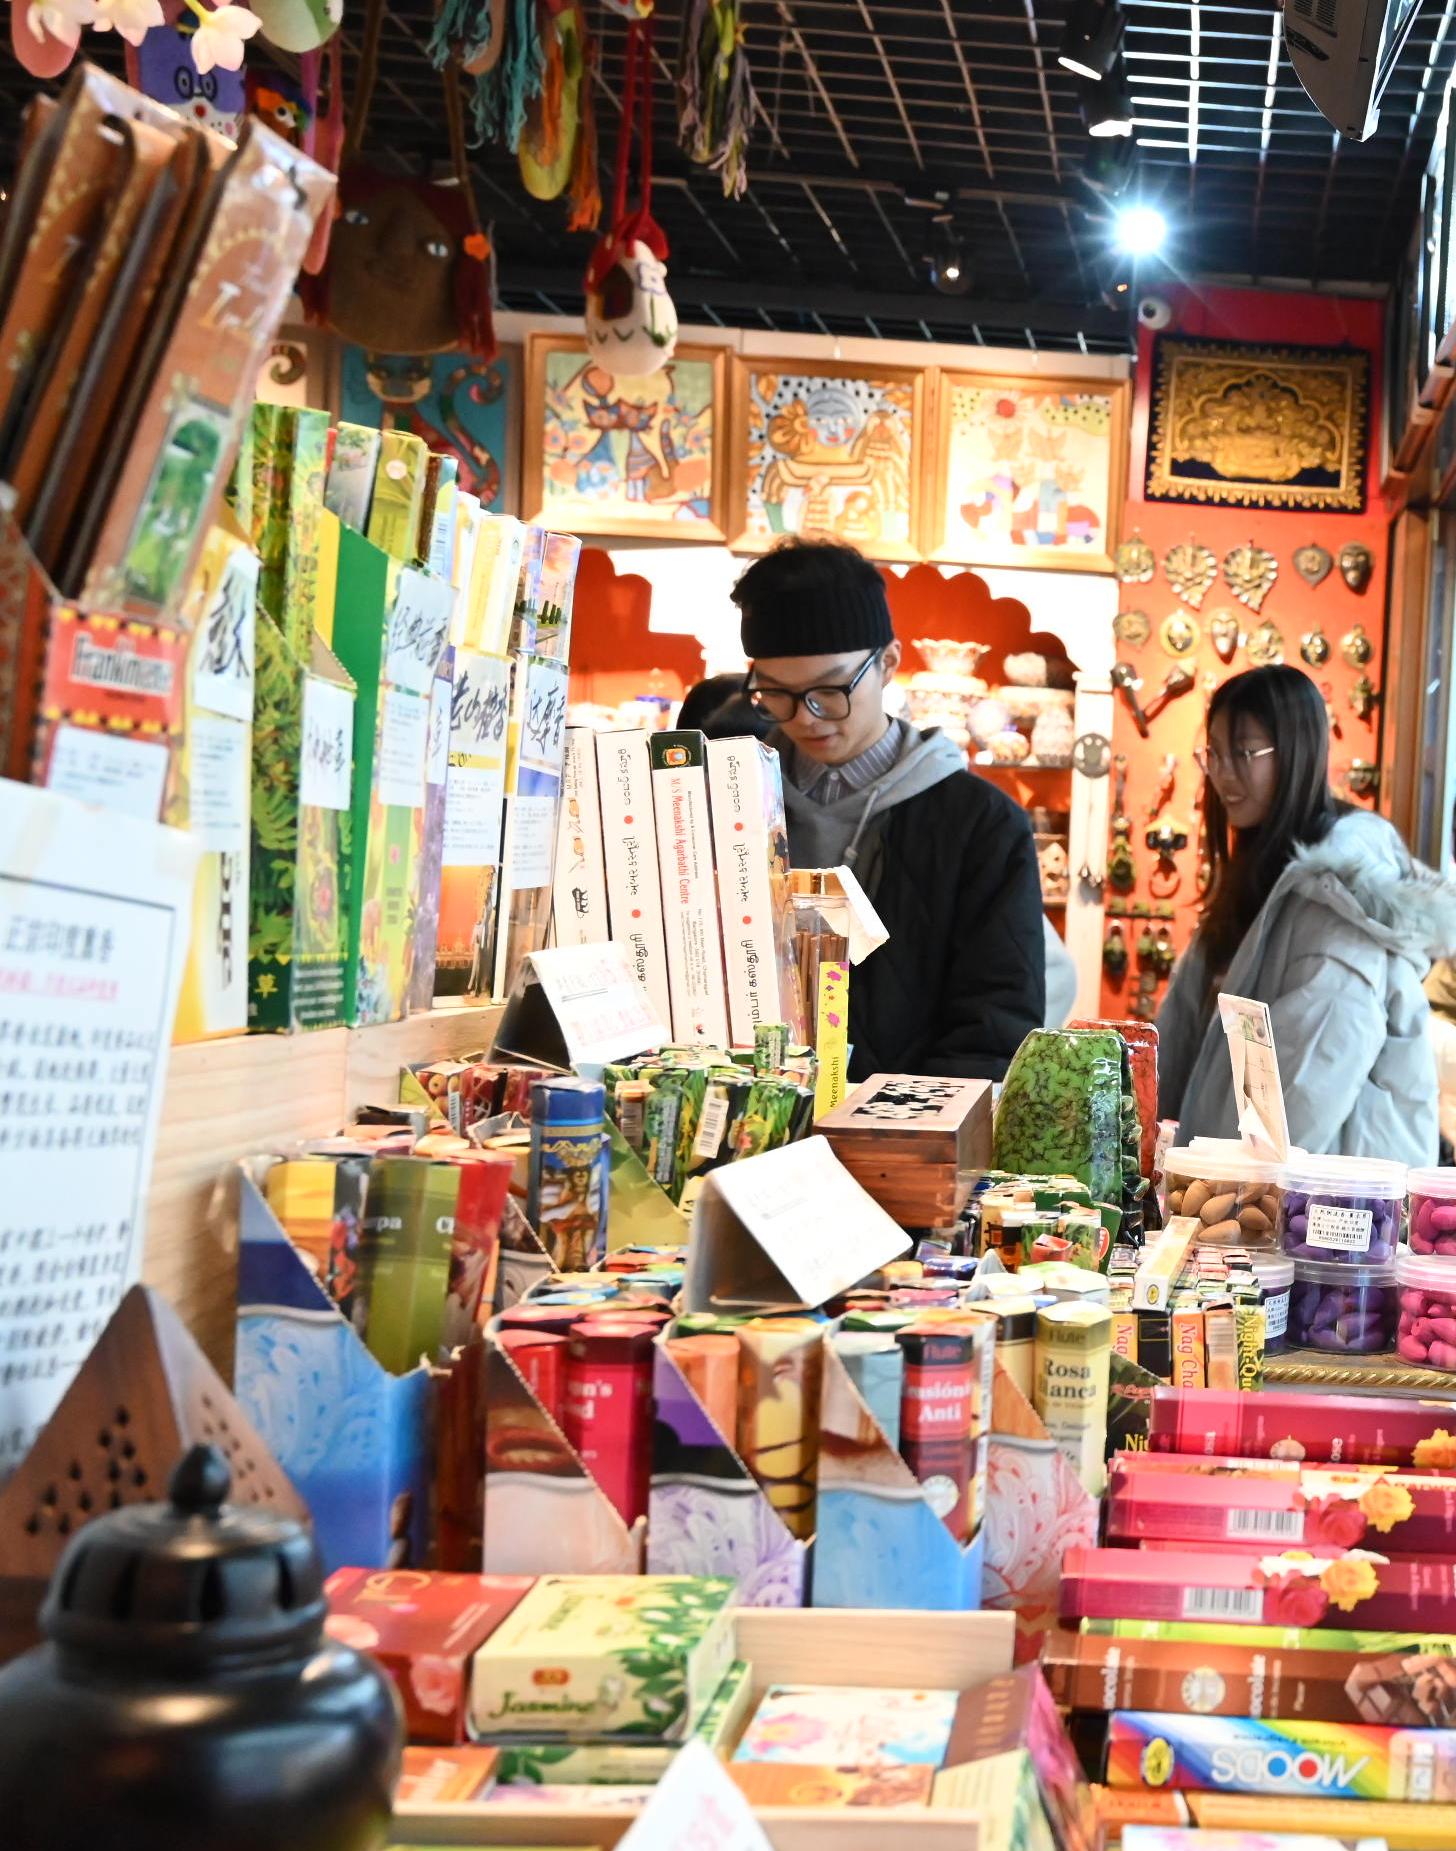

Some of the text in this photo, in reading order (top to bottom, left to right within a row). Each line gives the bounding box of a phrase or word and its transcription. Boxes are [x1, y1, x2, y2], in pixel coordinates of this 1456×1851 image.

[671, 794, 686, 838] Meenakshi
[672, 839, 689, 878] Agarbathi
[679, 878, 689, 904] Centre
[254, 973, 279, 998] 草
[829, 1057, 839, 1108] Meenakshi
[1177, 1322, 1196, 1354] Nag
[919, 1403, 962, 1423] Anti
[1210, 1748, 1370, 1790] MOODS
